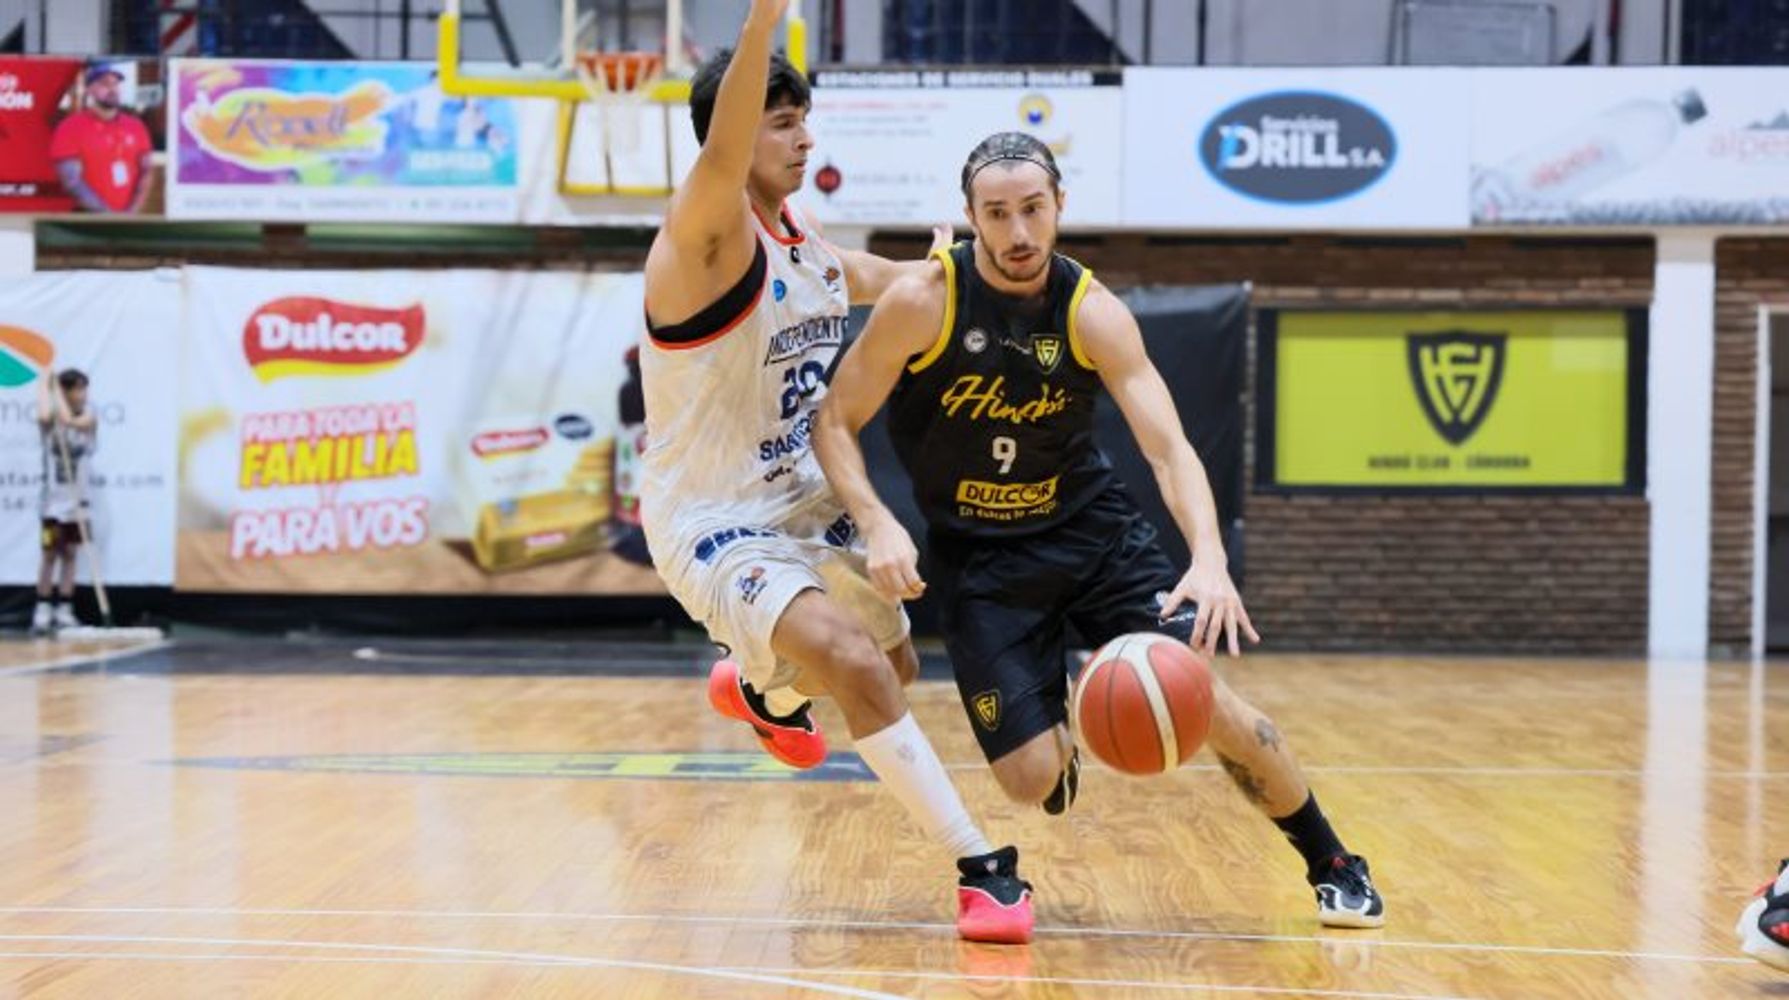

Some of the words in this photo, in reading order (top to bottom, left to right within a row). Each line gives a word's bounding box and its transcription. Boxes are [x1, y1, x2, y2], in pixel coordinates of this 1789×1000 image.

[1217, 125, 1349, 169] DRILL
[780, 360, 827, 419] 20
[239, 428, 419, 490] FAMILIA
[992, 436, 1017, 474] 9
[965, 482, 1051, 504] DULCOR
[231, 506, 339, 560] PARA
[347, 496, 428, 551] VOS
